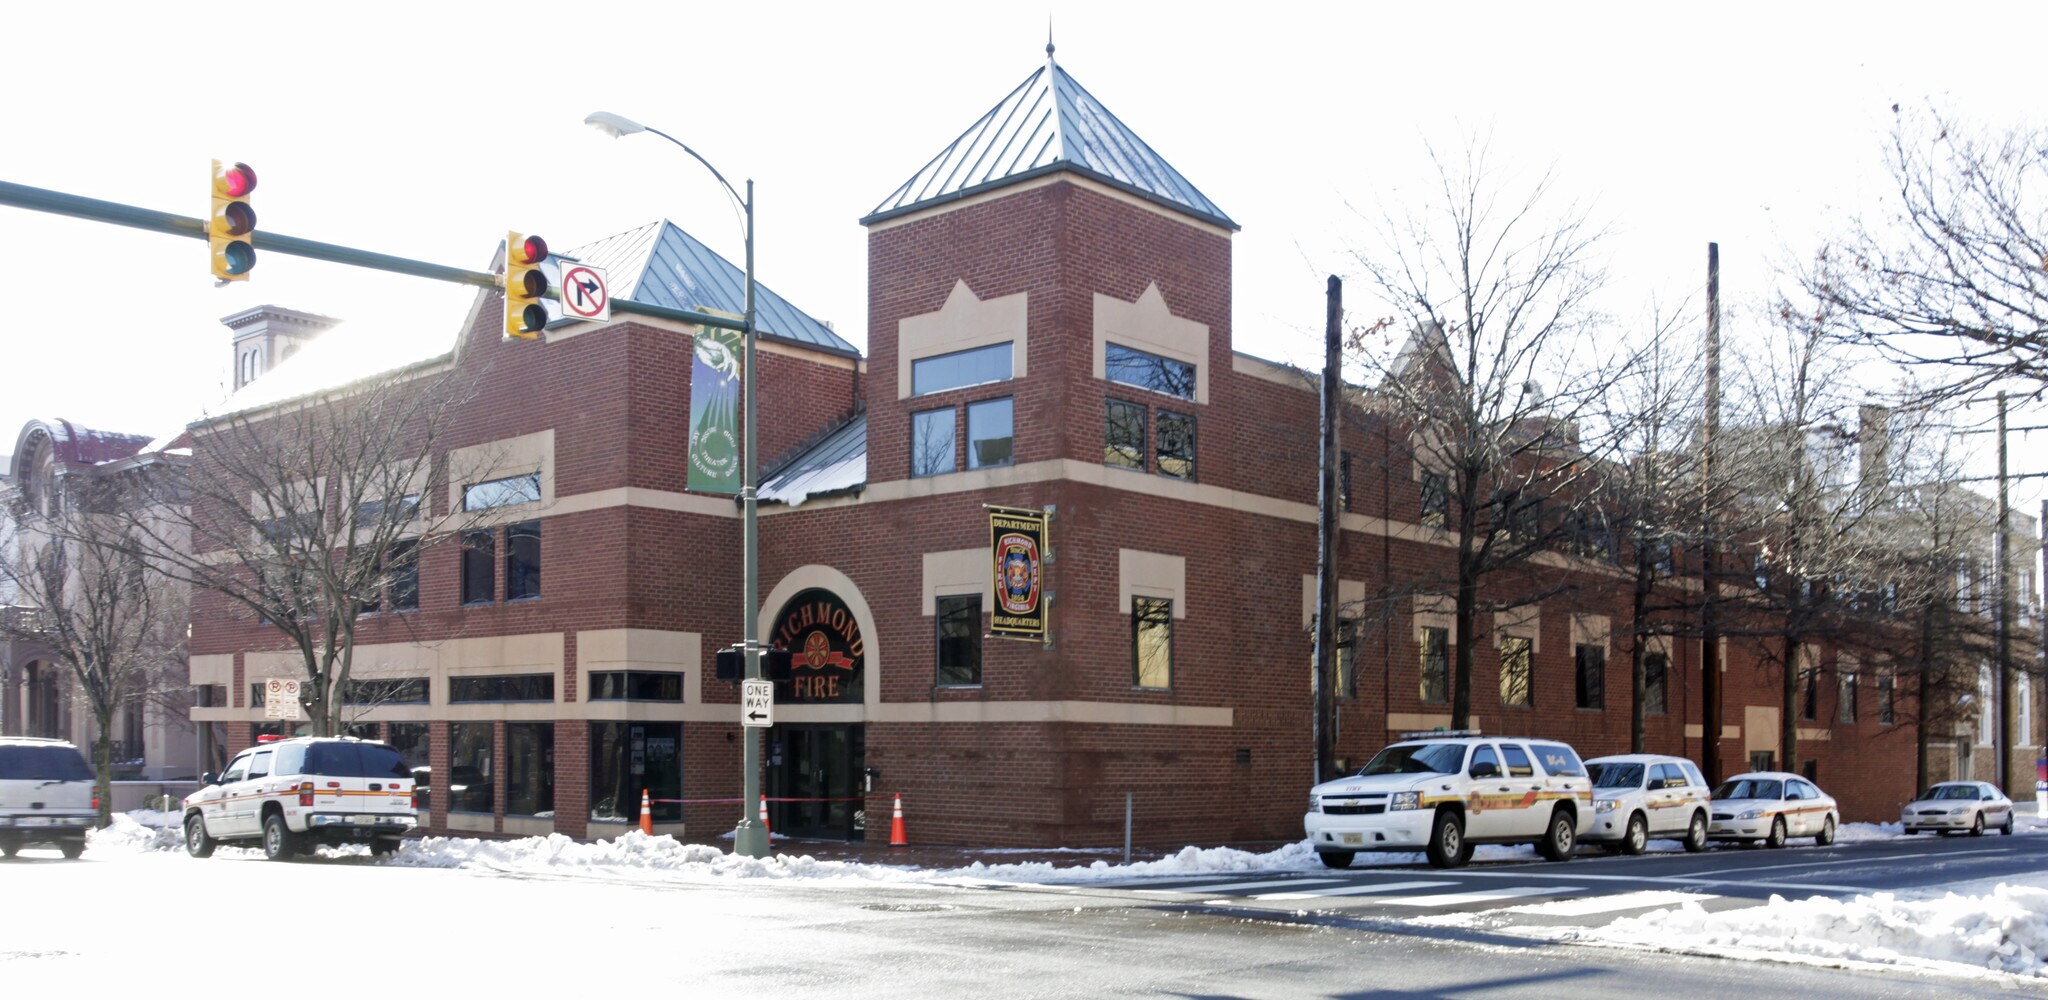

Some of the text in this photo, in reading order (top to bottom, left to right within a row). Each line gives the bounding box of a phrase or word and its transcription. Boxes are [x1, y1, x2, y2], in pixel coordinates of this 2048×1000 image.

[691, 453, 717, 478] CULTURE
[993, 519, 1040, 531] DEPARTMENT
[1004, 537, 1032, 549] RICHMOND
[994, 616, 1040, 627] HEADQUARTERS
[747, 685, 769, 696] ONE
[794, 675, 839, 698] FIRE
[747, 697, 769, 708] WAY
